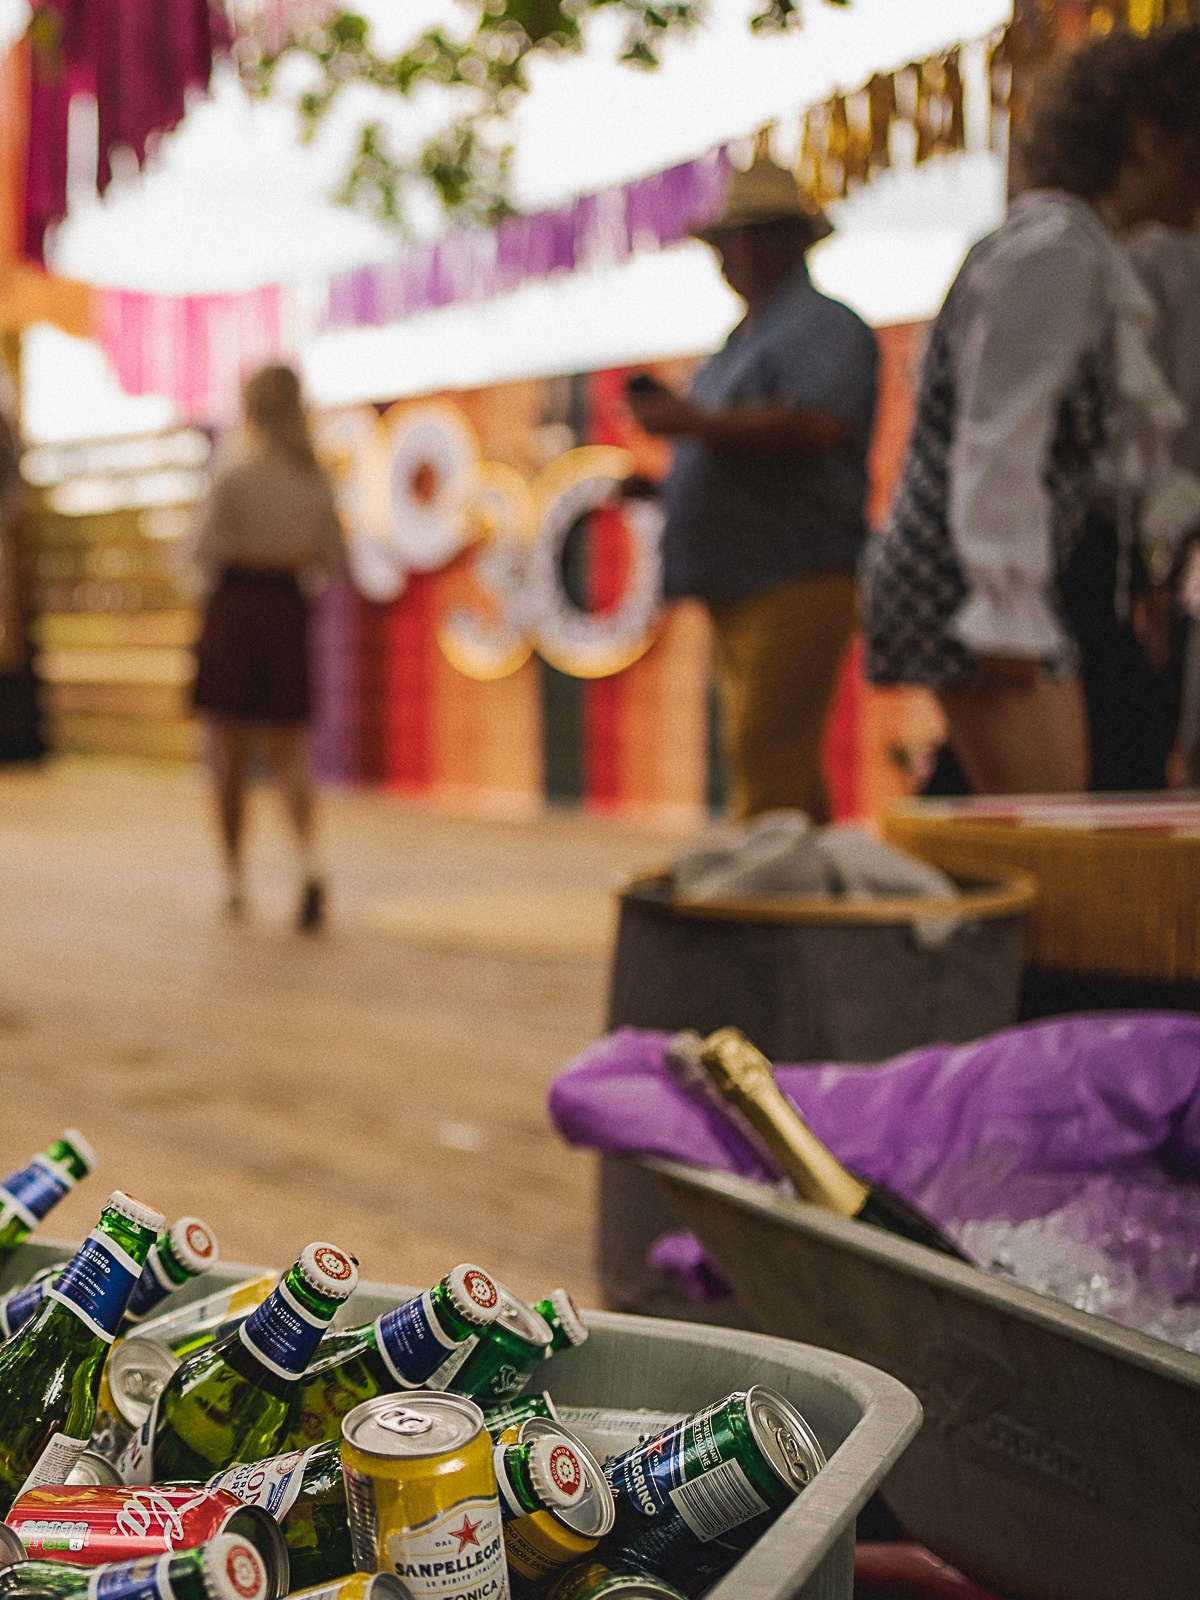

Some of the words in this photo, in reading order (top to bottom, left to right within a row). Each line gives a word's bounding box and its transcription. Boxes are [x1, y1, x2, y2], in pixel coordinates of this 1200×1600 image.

[82, 1251, 110, 1273] AZZURRO
[273, 1307, 302, 1335] AZZURRO
[694, 1433, 711, 1467] ITALIANE
[702, 1425, 720, 1463] SELEZIONATI
[652, 1454, 660, 1470] 1932
[270, 1477, 290, 1512] SUPERIORE
[395, 1534, 500, 1578] SANPELLEGRI
[435, 1540, 453, 1548] DAL
[517, 1538, 537, 1556] SUCCHI
